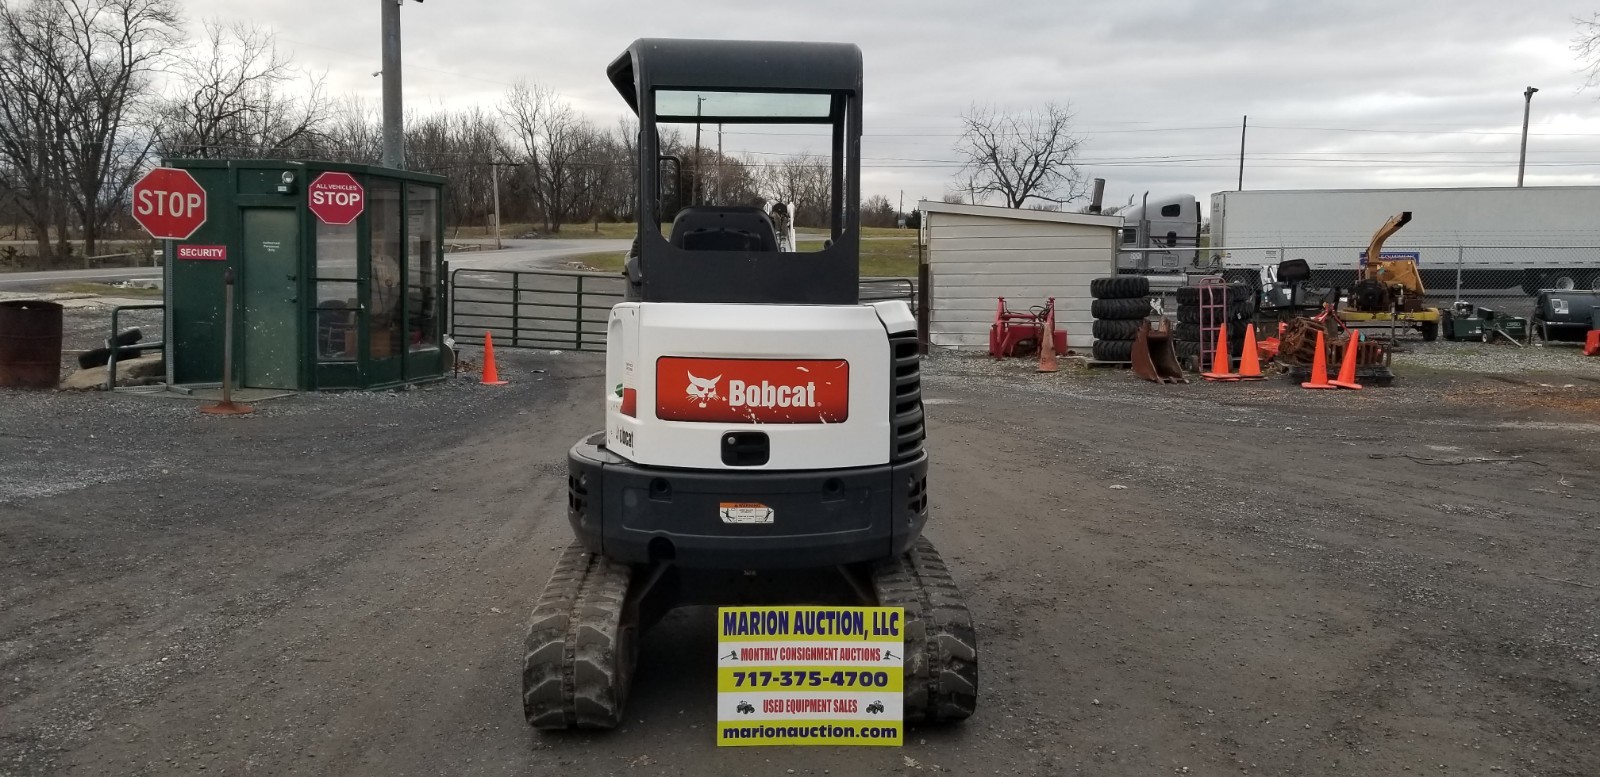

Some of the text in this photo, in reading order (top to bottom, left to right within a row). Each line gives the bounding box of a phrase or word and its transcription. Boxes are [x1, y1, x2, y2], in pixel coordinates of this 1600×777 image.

[138, 190, 201, 218] STOP
[313, 191, 360, 206] STOP
[180, 249, 223, 257] SECURITY
[729, 380, 816, 408] Bobcat
[723, 610, 899, 640] MARION AUCTION, LLC
[740, 647, 881, 662] MONTHLY CONSIGNMENT AUCTIONS
[733, 671, 888, 687] 717-375-4700
[763, 699, 858, 714] USED EQUIPMENT SALES
[723, 725, 897, 738] marionauction.com
